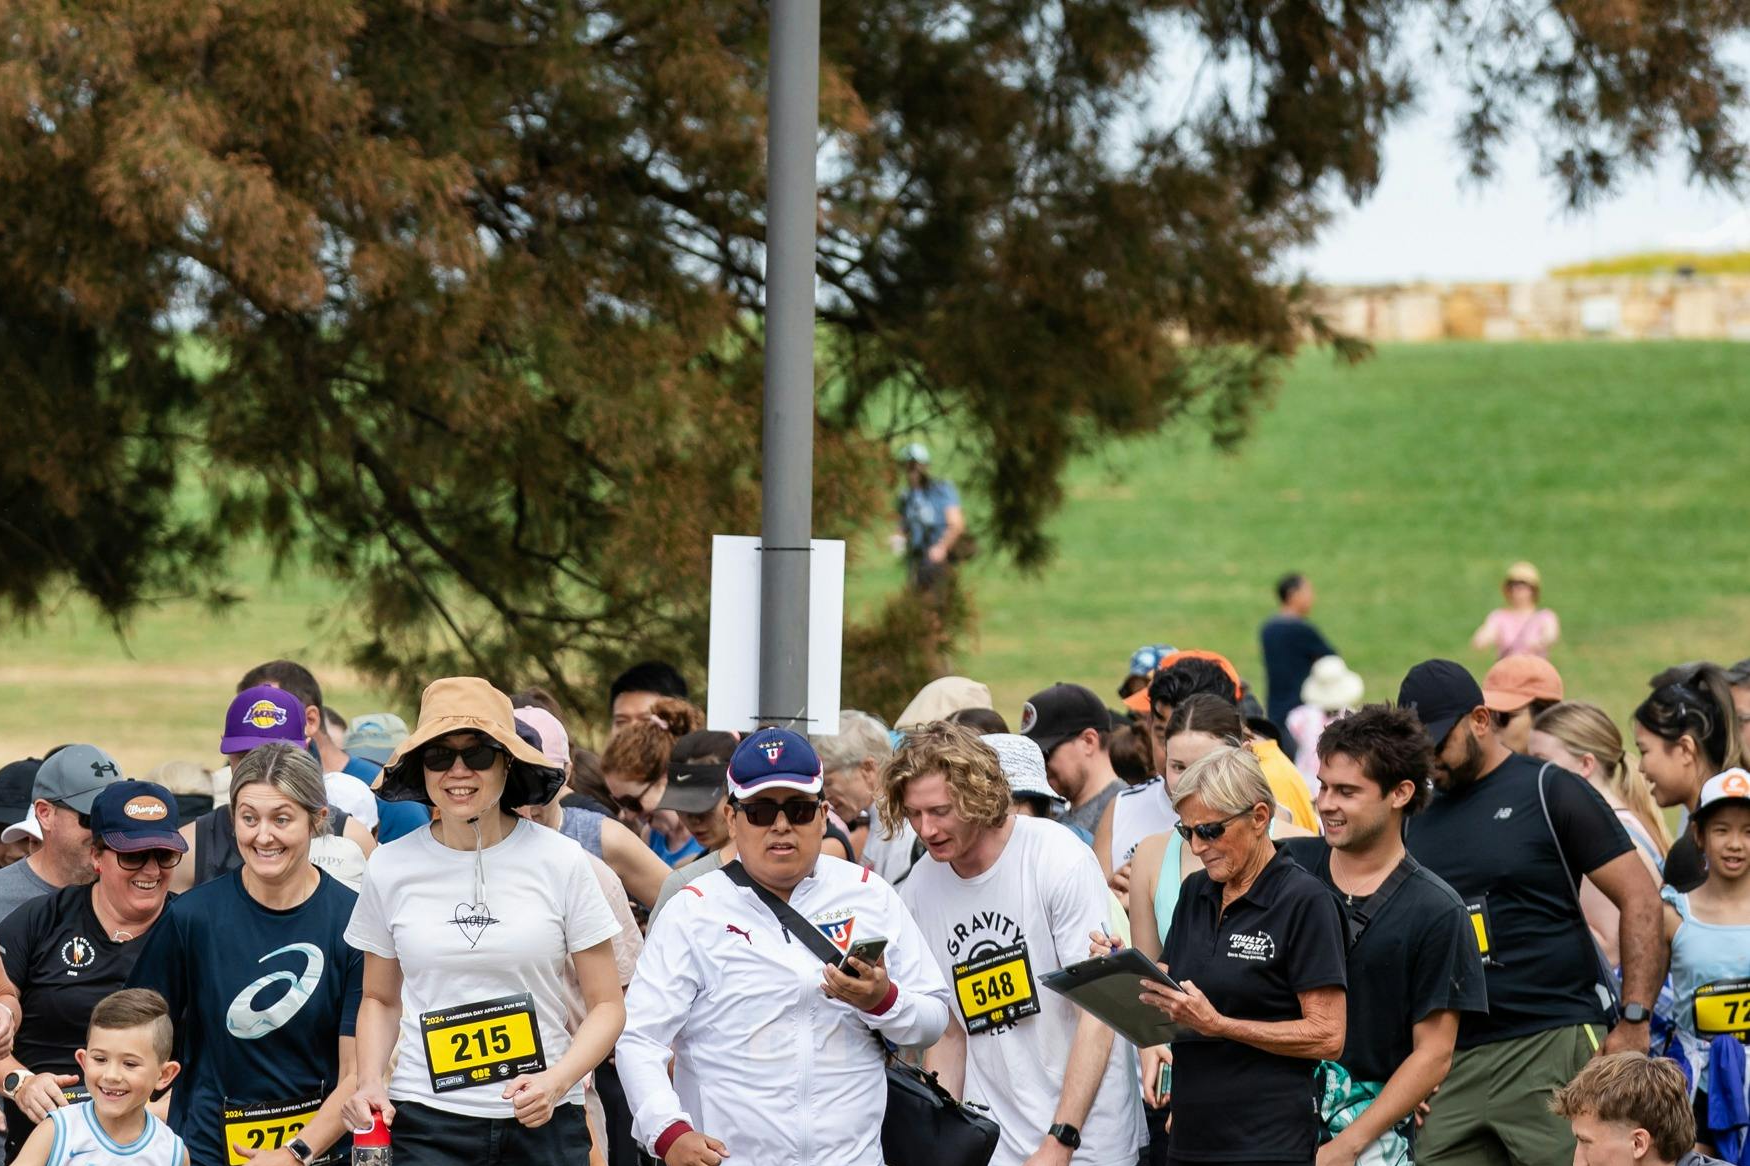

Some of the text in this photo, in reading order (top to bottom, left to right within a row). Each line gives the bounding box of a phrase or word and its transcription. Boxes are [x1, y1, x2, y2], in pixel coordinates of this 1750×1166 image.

[127, 803, 166, 817] Wrangler
[828, 924, 848, 943] U
[947, 911, 1025, 957] GRAVITY
[1229, 934, 1267, 945] MULTI
[1230, 941, 1269, 952] SPORT
[971, 971, 1015, 1007] 548
[425, 1015, 445, 1026] 2024
[445, 1011, 473, 1022] CANBERRA
[483, 1005, 504, 1014] APPEAL
[450, 1024, 511, 1063] 215
[63, 1091, 76, 1099] 024
[224, 1109, 244, 1118] 2024
[244, 1109, 271, 1117] CANBERRA
[282, 1103, 302, 1112] APPEAL
